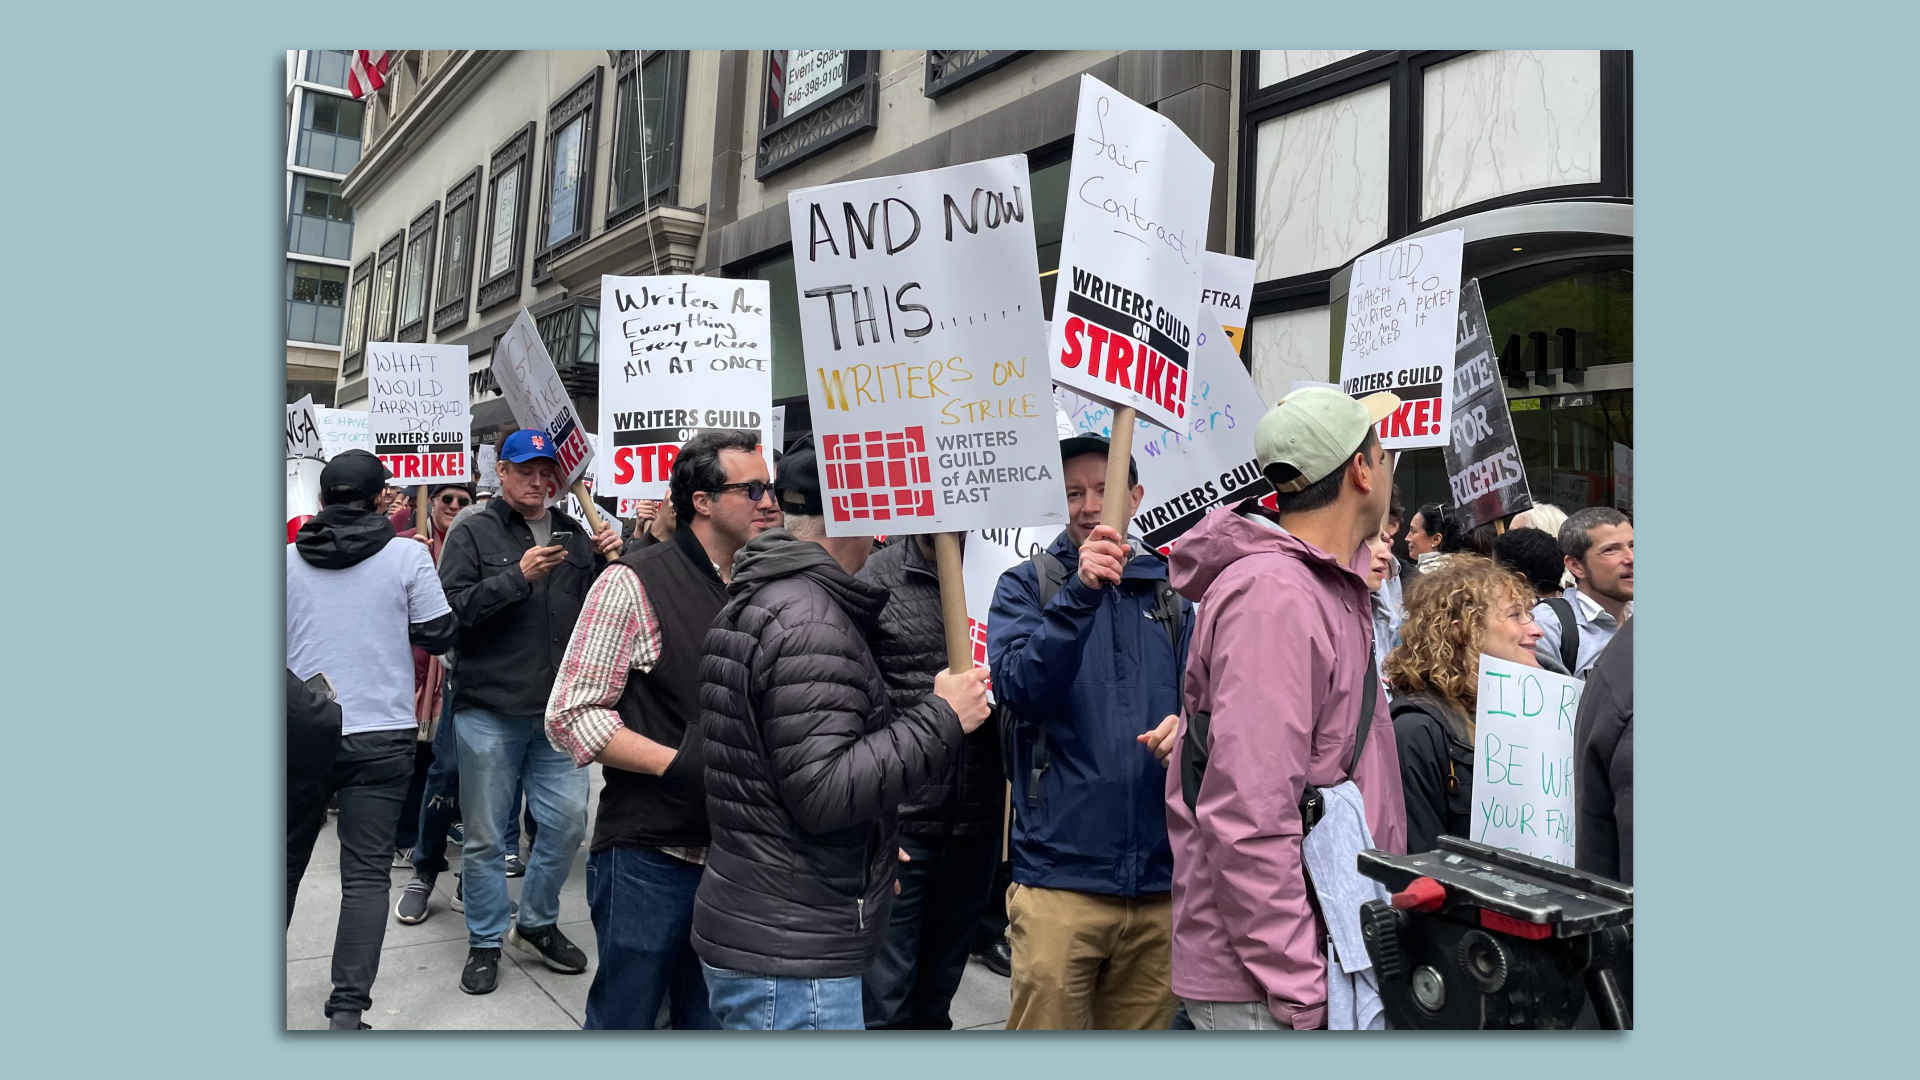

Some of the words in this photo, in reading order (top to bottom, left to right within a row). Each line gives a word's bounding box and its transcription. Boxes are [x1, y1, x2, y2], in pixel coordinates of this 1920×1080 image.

[787, 62, 844, 107] 646-398-9100
[789, 58, 814, 85] Event
[810, 198, 921, 262] AND
[943, 186, 1024, 242] NOW
[1356, 260, 1366, 288] I
[615, 283, 719, 313] Writers
[731, 287, 764, 316] Are
[1072, 265, 1153, 322] WRITERS
[1156, 306, 1190, 349] GUILD
[1397, 298, 1407, 313] A
[1132, 321, 1150, 343] ON
[373, 352, 438, 373] WHAT
[709, 355, 770, 373] ONCE
[1060, 316, 1188, 419] STRIKE!
[374, 377, 443, 398] WOULD
[817, 357, 973, 412] WRITERS
[992, 357, 1028, 386] ON
[1343, 370, 1393, 395] WRITERS
[1397, 365, 1443, 386] GUILD
[371, 397, 418, 417] LARRY
[420, 400, 463, 417] DAVID
[551, 405, 570, 435] GUILD
[613, 409, 698, 430] WRITERS
[704, 410, 761, 428] GUILD
[941, 394, 1039, 425] STRIKE
[376, 432, 430, 444] WRITERS
[432, 431, 463, 443] GUILD
[936, 430, 1018, 451] WRITERS
[1451, 404, 1493, 454] FOR
[939, 450, 996, 469] GUILD
[941, 472, 959, 487] of
[966, 465, 1052, 486] AMERICA
[1450, 446, 1522, 508] RIGHTS
[943, 487, 990, 505] EAST
[1134, 481, 1218, 534] WRITERS
[1486, 671, 1544, 718] I'D
[1485, 734, 1527, 784] BE
[1481, 797, 1537, 843] YOUR
